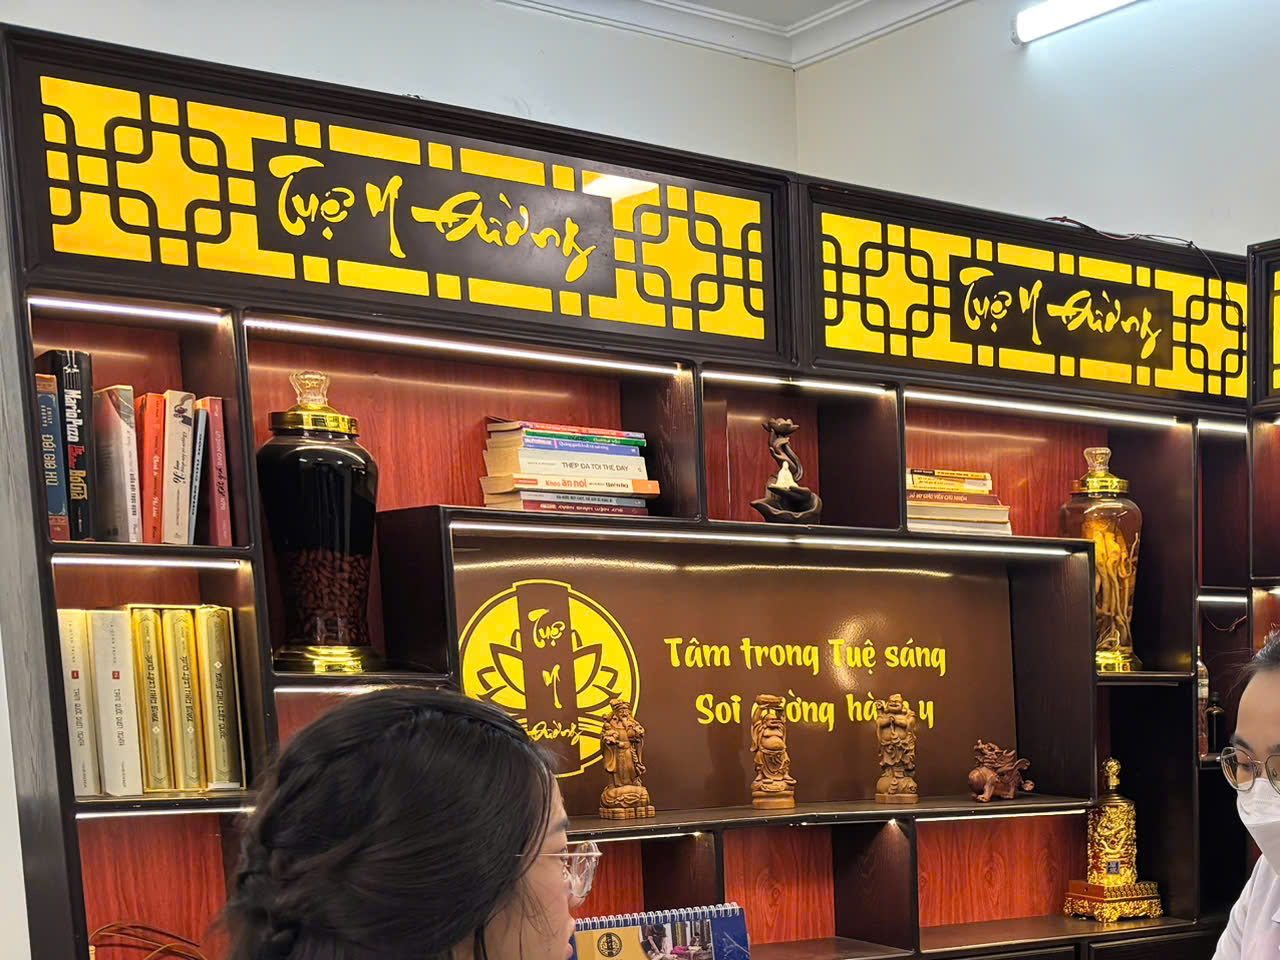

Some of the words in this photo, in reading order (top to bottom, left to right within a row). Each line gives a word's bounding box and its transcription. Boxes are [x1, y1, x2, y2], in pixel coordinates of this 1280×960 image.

[663, 636, 731, 668] Tâm
[740, 637, 819, 676] trong
[828, 638, 876, 675] Tuệ
[885, 638, 947, 677] sáng
[695, 693, 742, 725] Soi
[751, 689, 835, 732] ờng
[845, 691, 910, 722] hà
[918, 700, 934, 729] y
